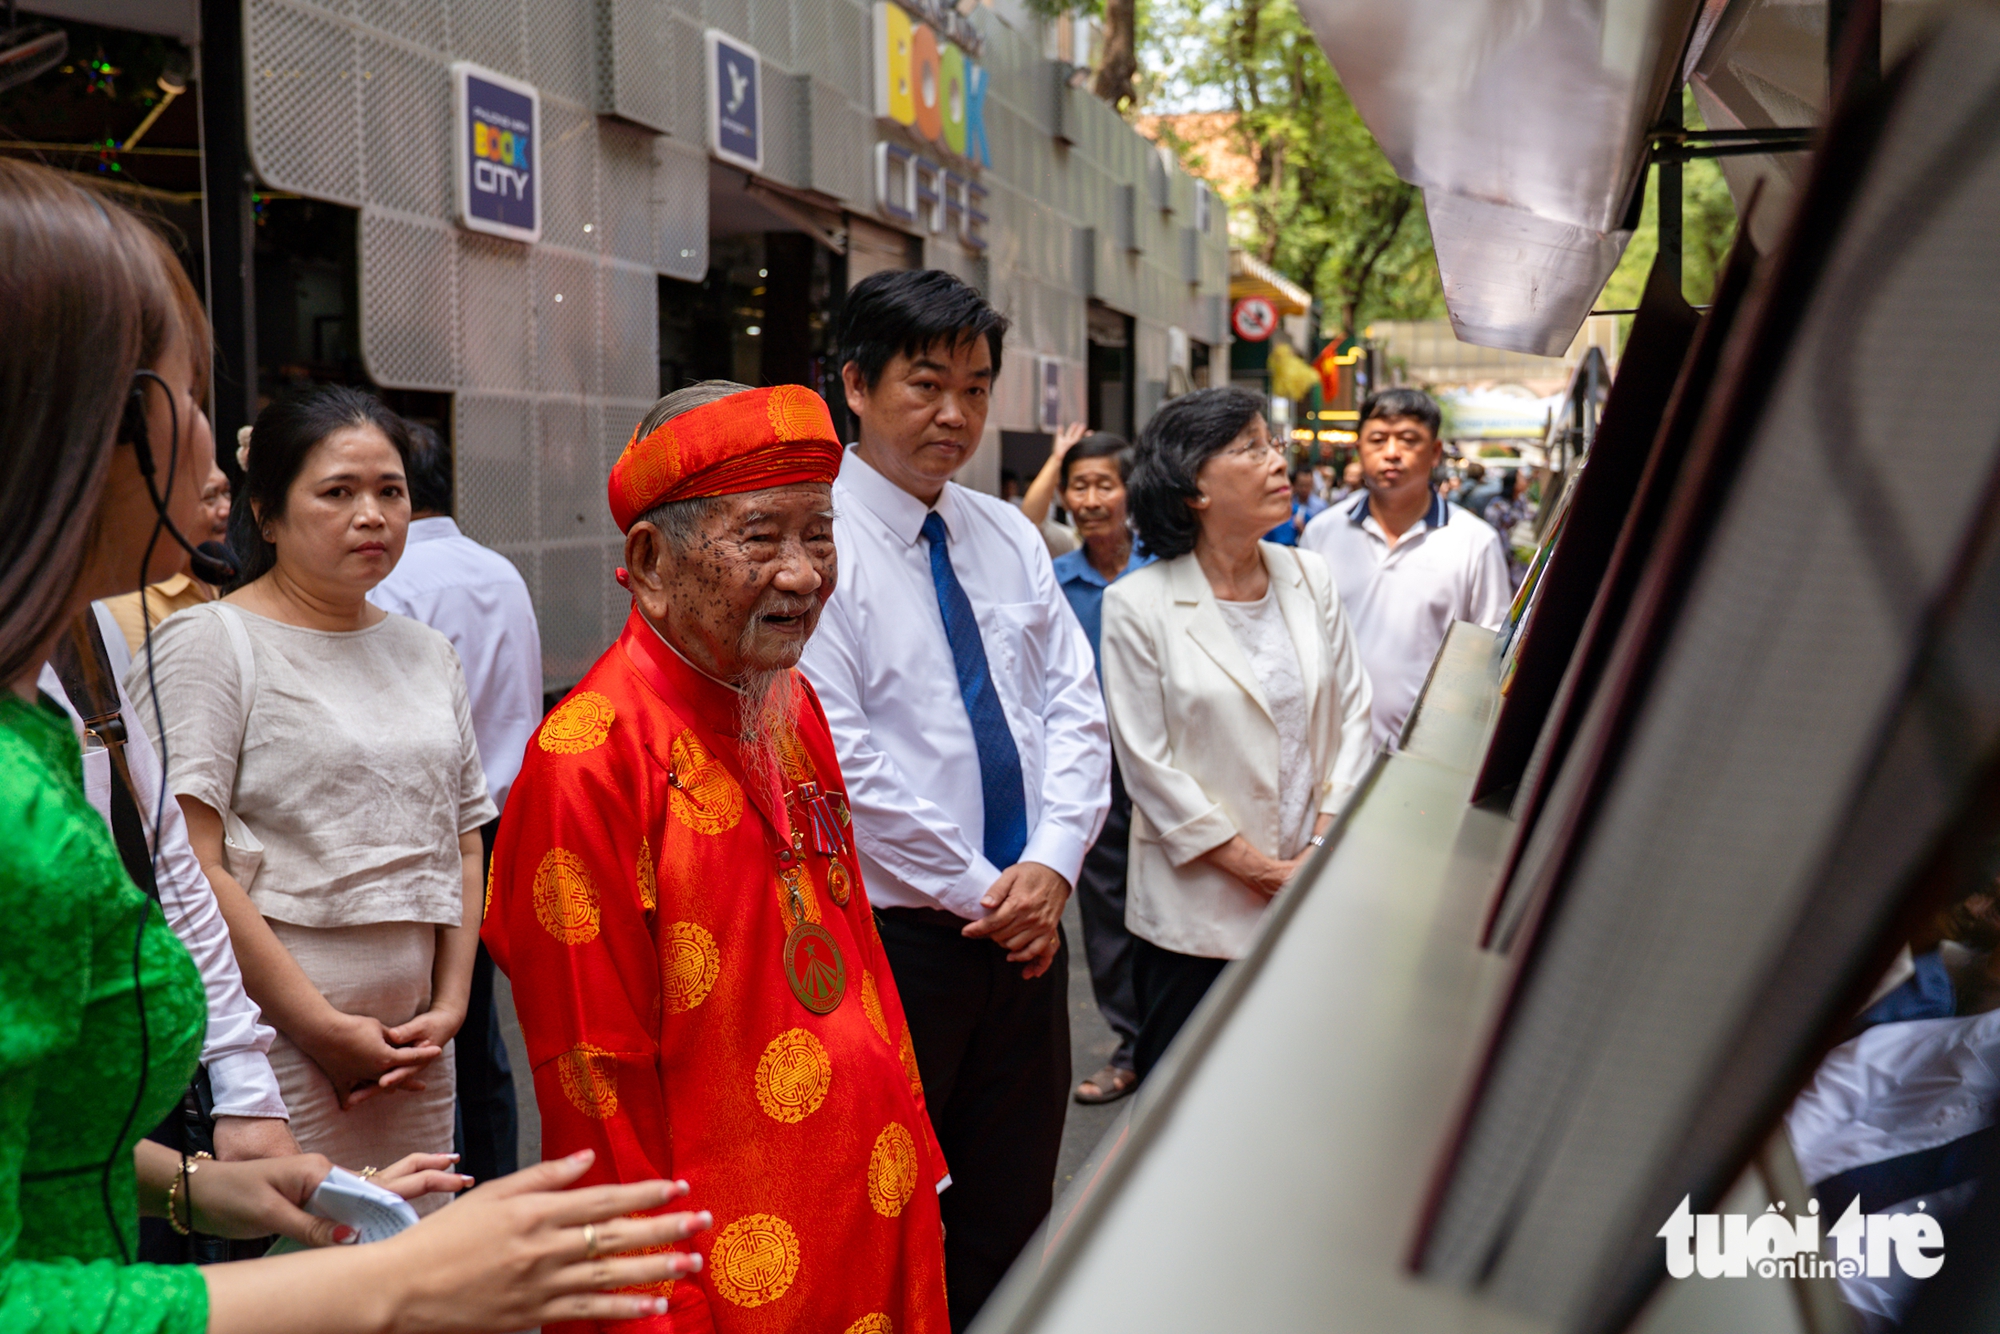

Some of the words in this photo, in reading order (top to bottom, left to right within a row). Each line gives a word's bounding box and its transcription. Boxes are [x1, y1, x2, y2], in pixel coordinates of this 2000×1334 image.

[874, 1, 992, 169] BOOK
[474, 121, 529, 170] BOOK
[474, 159, 529, 200] CITY
